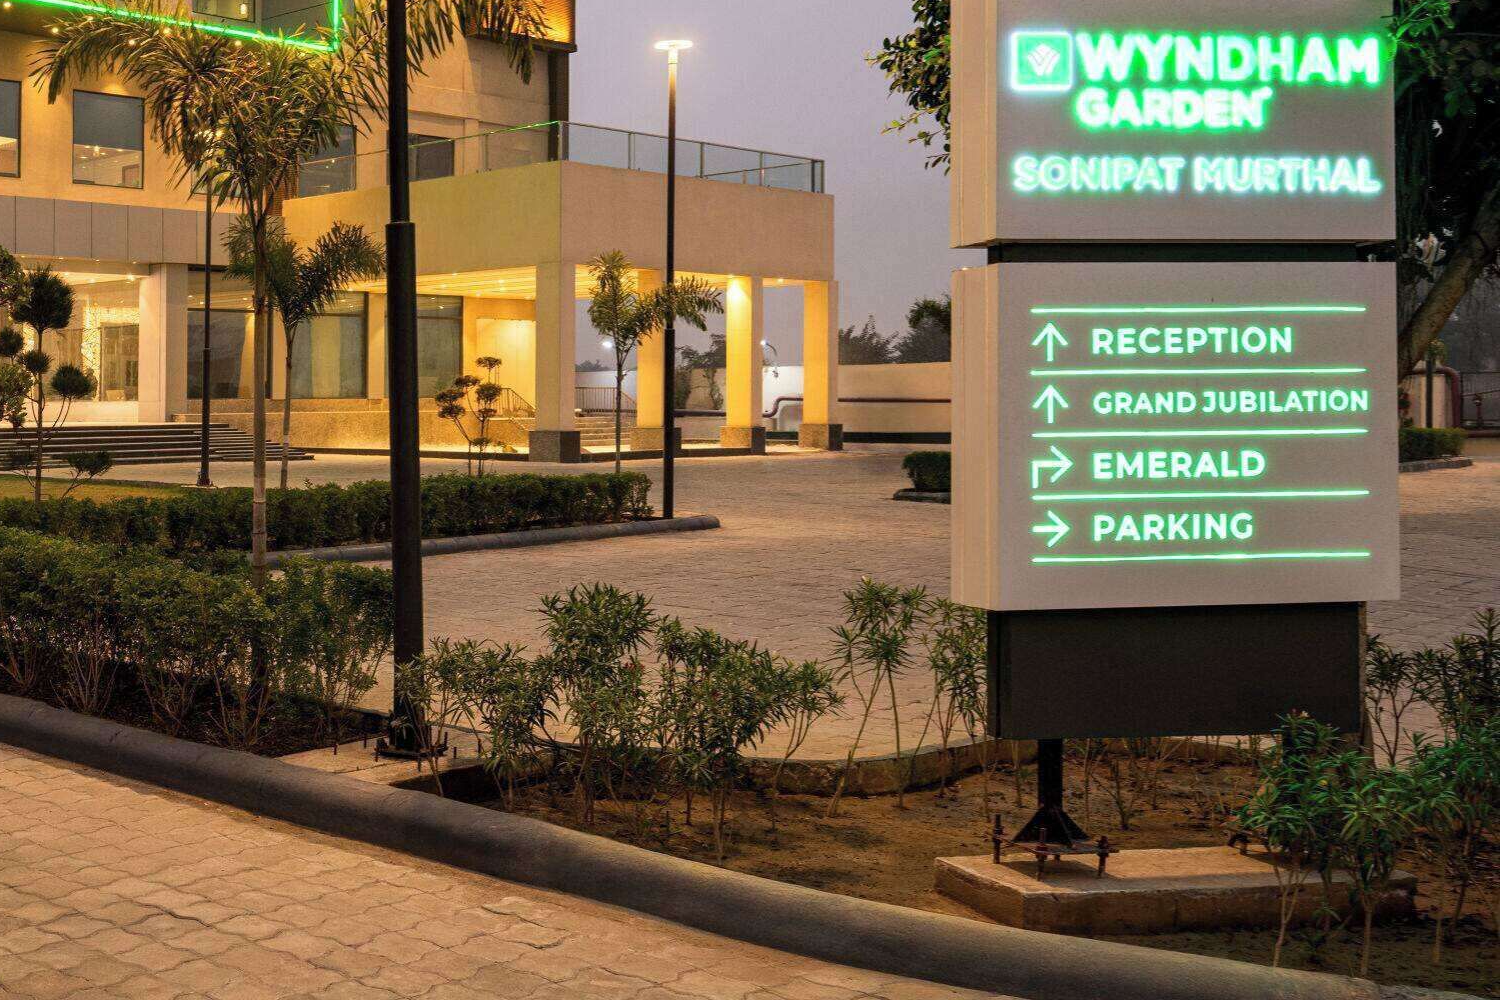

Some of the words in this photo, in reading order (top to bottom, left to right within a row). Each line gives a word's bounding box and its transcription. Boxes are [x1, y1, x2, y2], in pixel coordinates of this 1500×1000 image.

[1075, 32, 1380, 83] WYNDHAM
[1075, 87, 1266, 129] GARDEN
[1012, 155, 1185, 192] SONIPAT
[1192, 156, 1382, 194] MURTHAL
[1092, 326, 1293, 355] RECEPTION
[1093, 391, 1197, 415] GRAND
[1201, 389, 1369, 414] JUBILATION
[1092, 449, 1266, 480] EMERALD
[1093, 512, 1254, 542] PARKING
